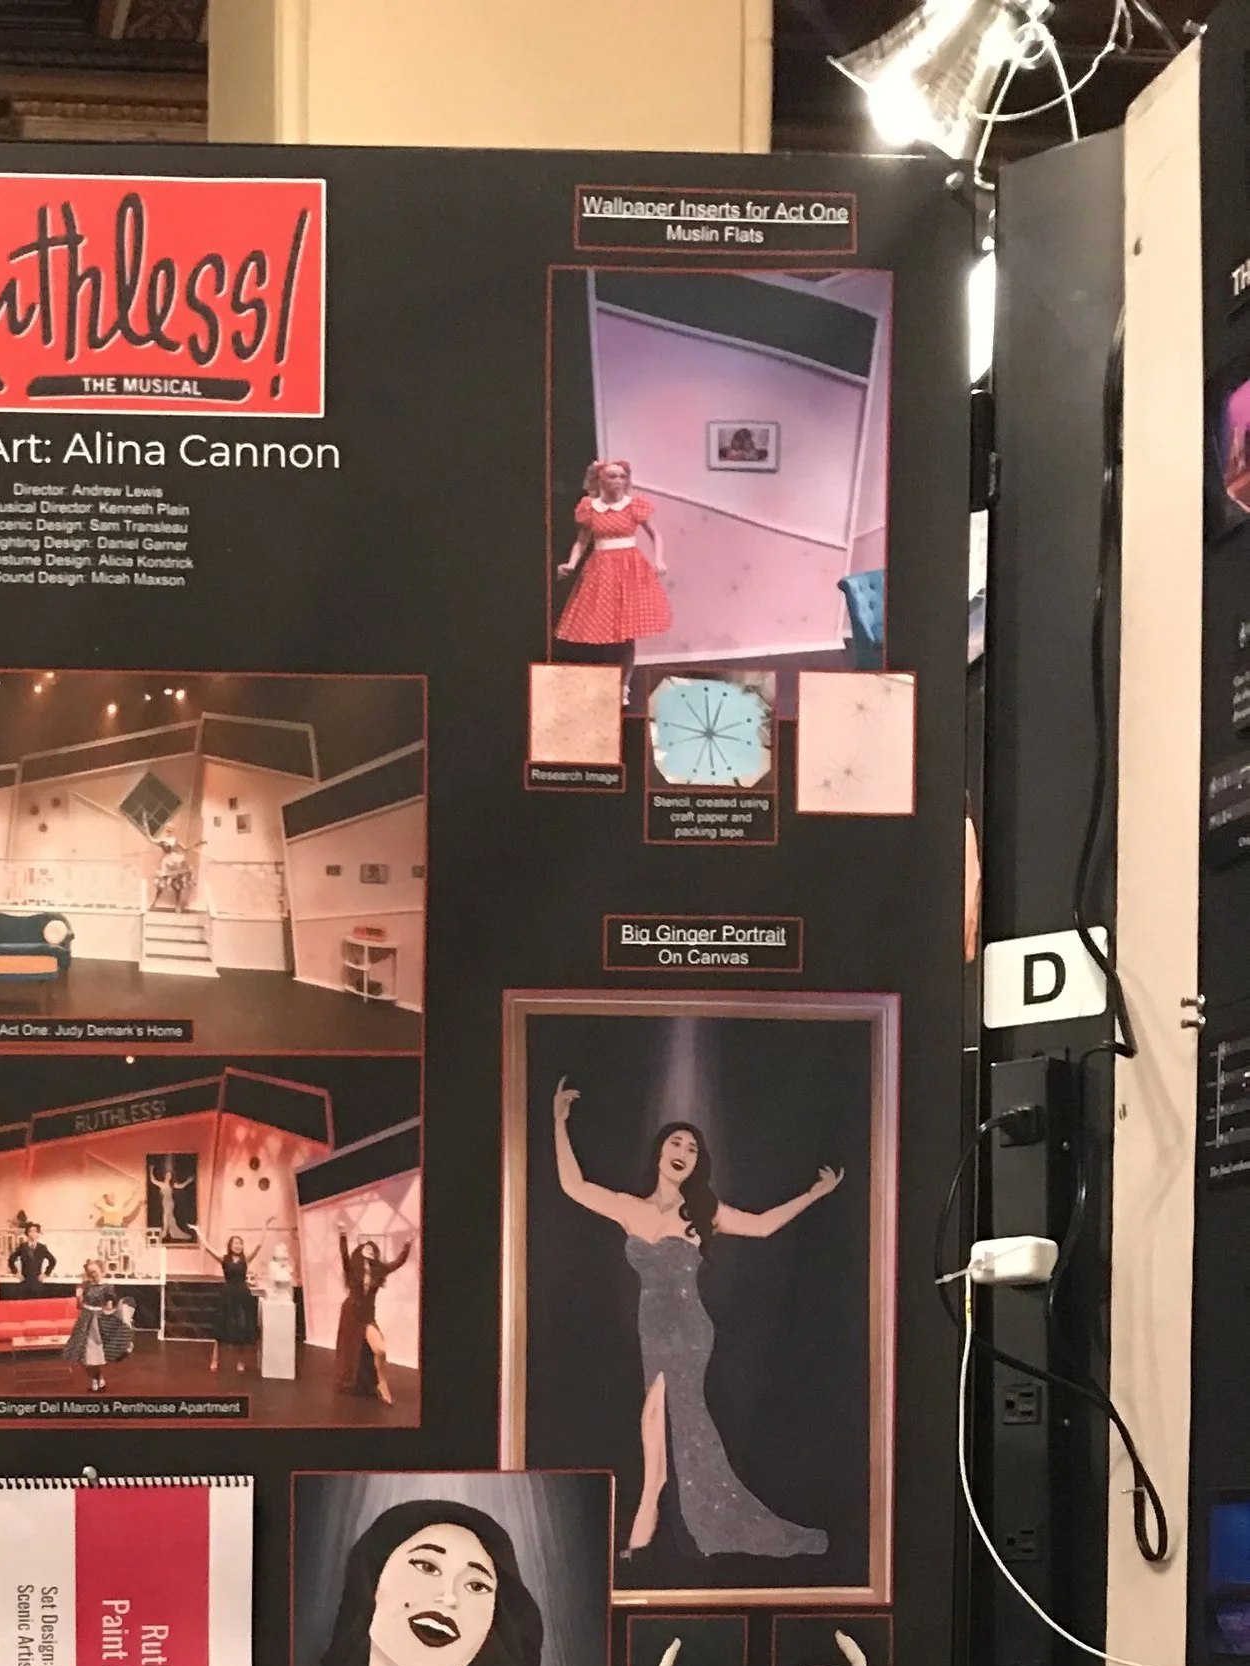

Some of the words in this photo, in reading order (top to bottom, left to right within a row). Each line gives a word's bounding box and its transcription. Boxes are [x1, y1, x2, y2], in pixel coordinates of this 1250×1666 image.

[582, 196, 675, 216] Wallpaper
[680, 199, 740, 218] Inserts
[746, 201, 770, 219] for
[775, 202, 804, 220] Act
[809, 202, 848, 221] One
[666, 224, 719, 241] Muslin
[724, 226, 764, 243] Flats
[82, 376, 117, 392] THE
[123, 377, 202, 396] MUSICAL
[63, 432, 165, 466] Alina
[179, 434, 341, 468] Cannon
[13, 483, 67, 496] Director:
[72, 484, 122, 497] Andrew
[126, 485, 164, 498] Lewis
[99, 502, 153, 515] Kenneth
[36, 518, 85, 533] Design:
[89, 519, 120, 532] Sam
[97, 536, 139, 550] Daniel
[531, 769, 583, 782] Research
[585, 771, 619, 784] Image
[696, 797, 737, 809] created
[739, 799, 769, 812] using
[670, 811, 695, 823] craft
[697, 814, 729, 826] paper
[731, 812, 752, 824] and
[675, 826, 716, 839] packing
[621, 925, 650, 945] Big
[656, 925, 717, 945] Ginger
[722, 926, 786, 944] Portrait
[658, 949, 683, 966] On
[687, 950, 749, 966] Canvas
[1023, 951, 1066, 1006] D
[0, 1024, 19, 1035] Act
[55, 1024, 85, 1039] Judy
[147, 1025, 183, 1037] Home
[40, 1402, 61, 1413] Del
[113, 1402, 176, 1413] Penthouse
[179, 1402, 241, 1415] Apartment
[41, 1586, 59, 1610] Set
[17, 1583, 34, 1631] Scenic
[102, 1599, 130, 1659] Paint
[38, 1613, 59, 1666] Design:
